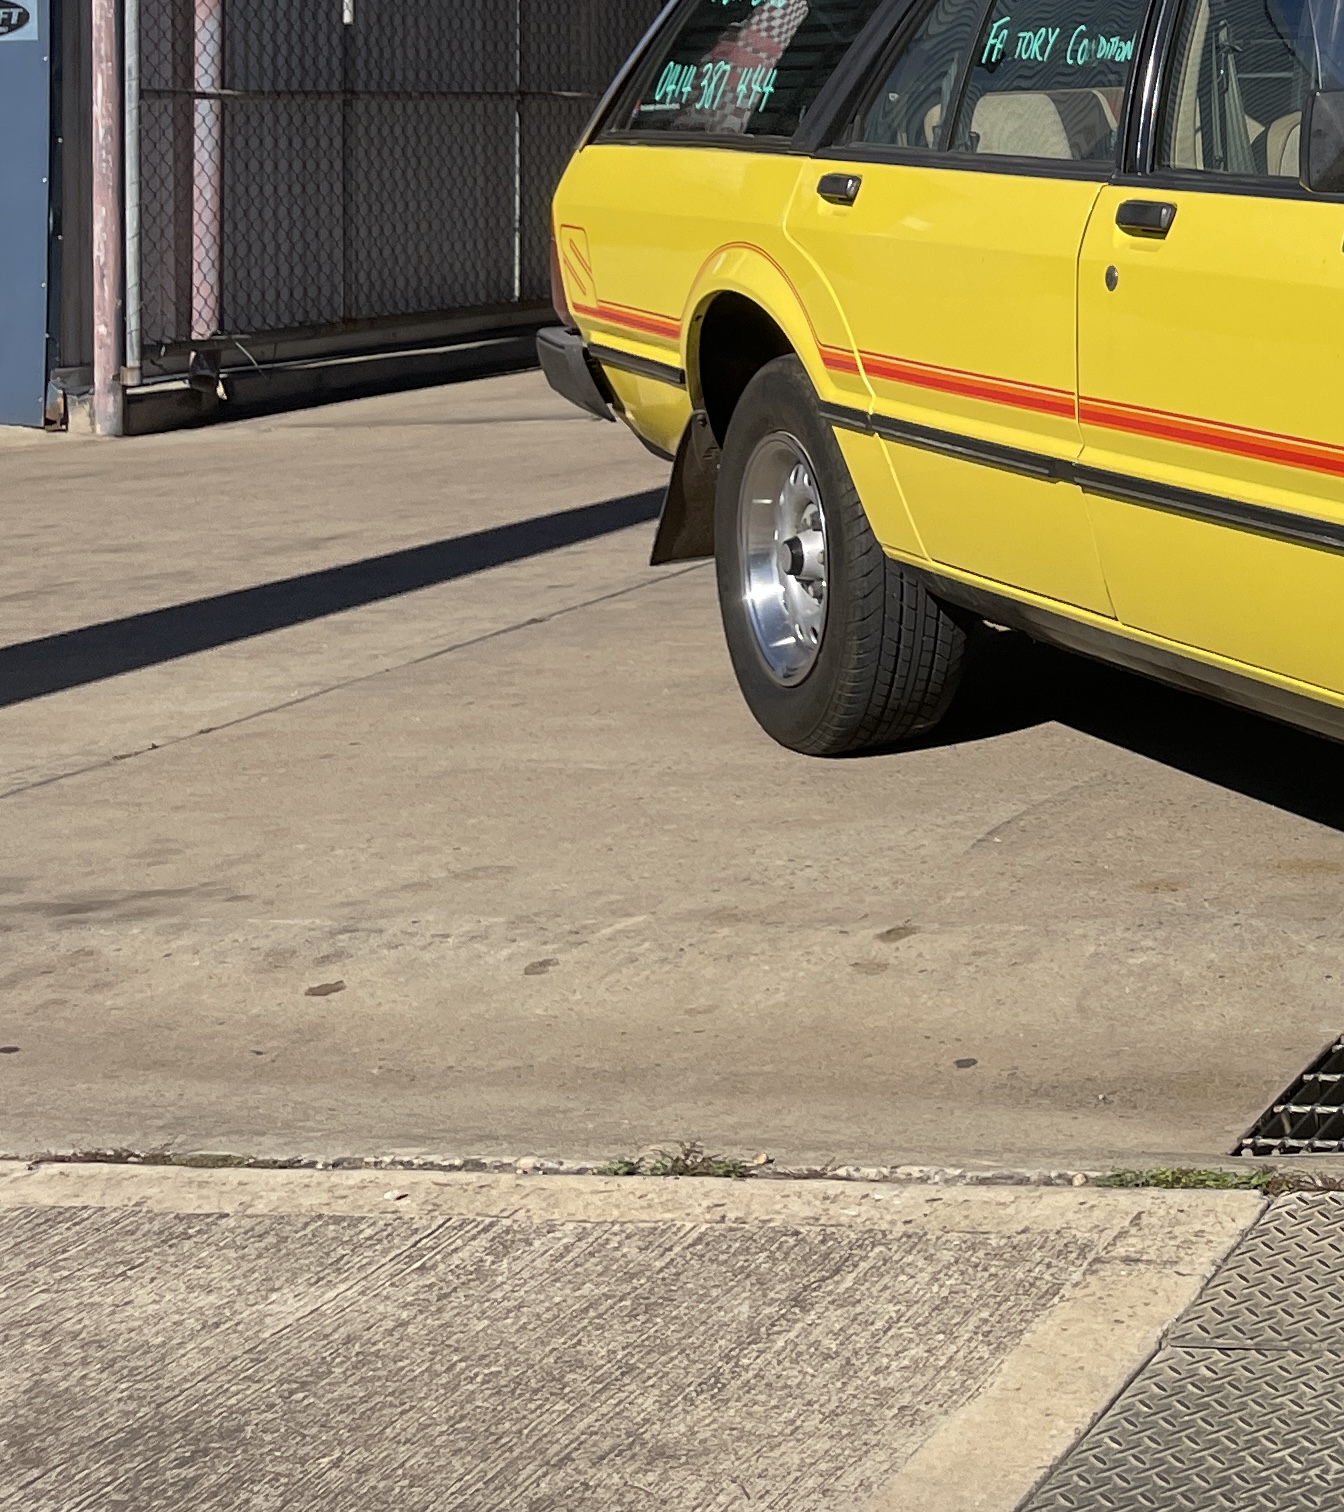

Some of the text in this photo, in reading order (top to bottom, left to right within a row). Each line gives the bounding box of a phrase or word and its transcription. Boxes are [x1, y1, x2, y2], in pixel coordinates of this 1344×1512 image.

[981, 16, 1060, 65] FATORY
[695, 60, 731, 110] 387
[736, 64, 778, 113] 444
